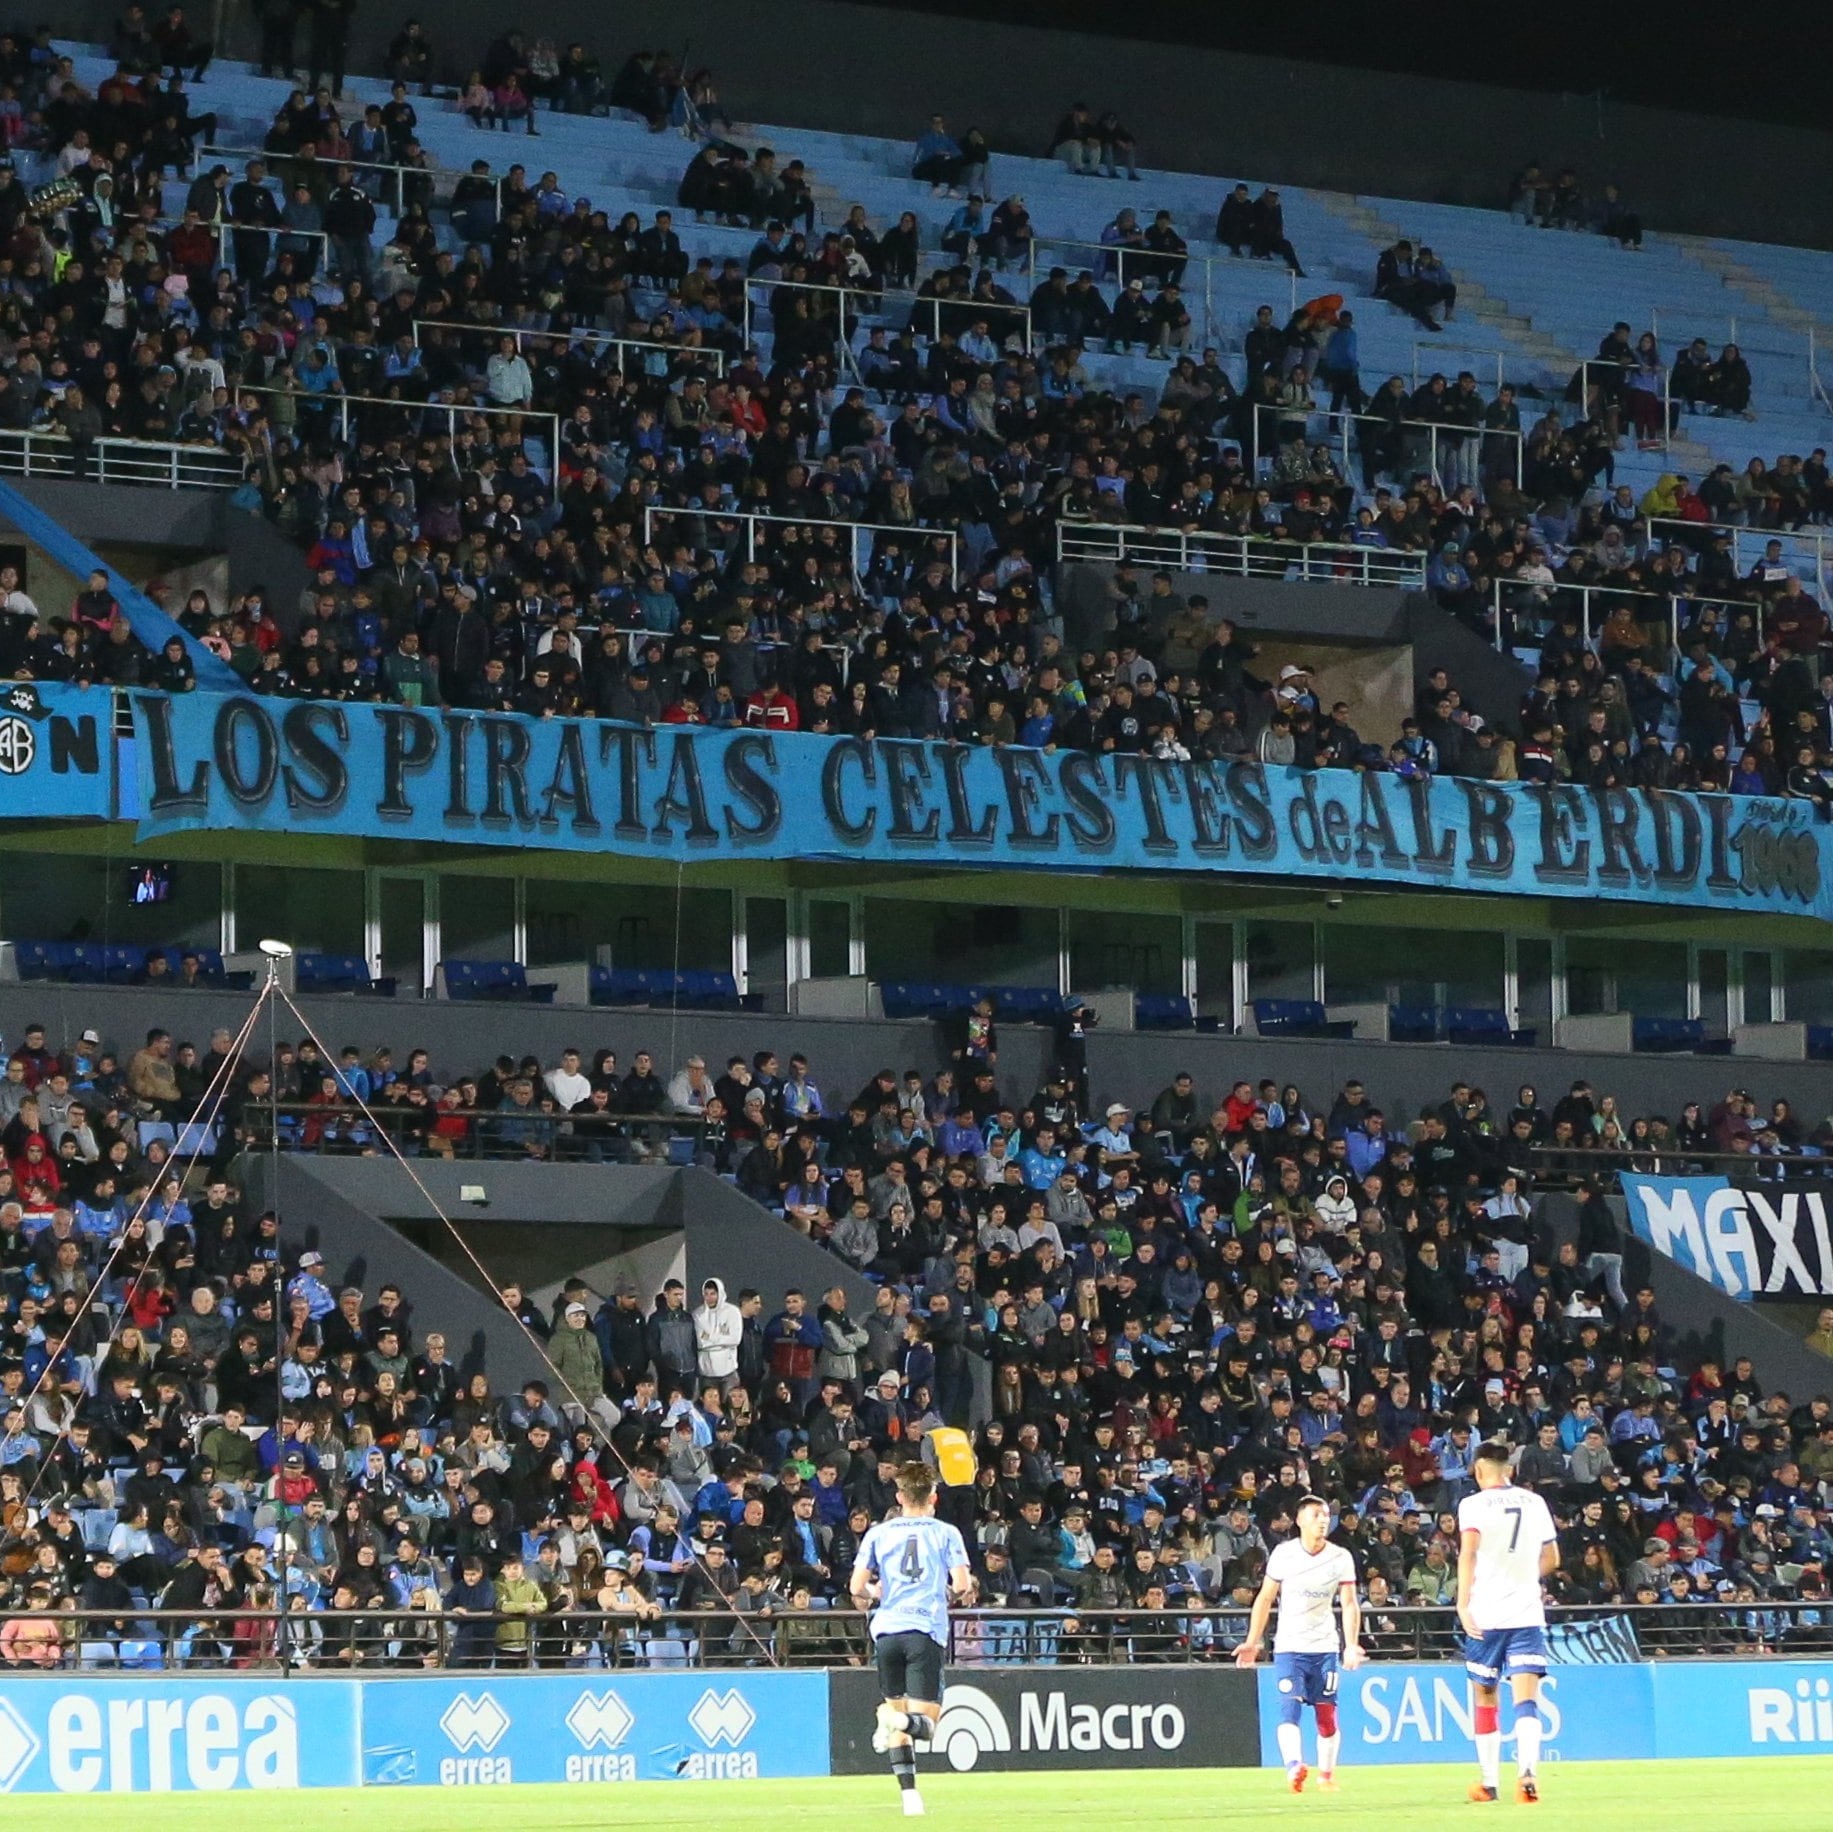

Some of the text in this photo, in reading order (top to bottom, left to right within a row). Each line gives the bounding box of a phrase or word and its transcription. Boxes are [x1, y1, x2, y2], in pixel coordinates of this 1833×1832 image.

[135, 694, 349, 812] LOS
[373, 707, 780, 847] PIRATAS
[821, 735, 1278, 861] CELESTES
[1289, 775, 1352, 864] de
[1355, 768, 1739, 897] ALBERDI
[1637, 1185, 1833, 1296] MAXI
[900, 1534, 924, 1583] 4
[1505, 1507, 1521, 1553] 7
[1020, 1691, 1186, 1751] Macro
[1360, 1676, 1561, 1744] SANS
[1748, 1677, 1833, 1743] Rii
